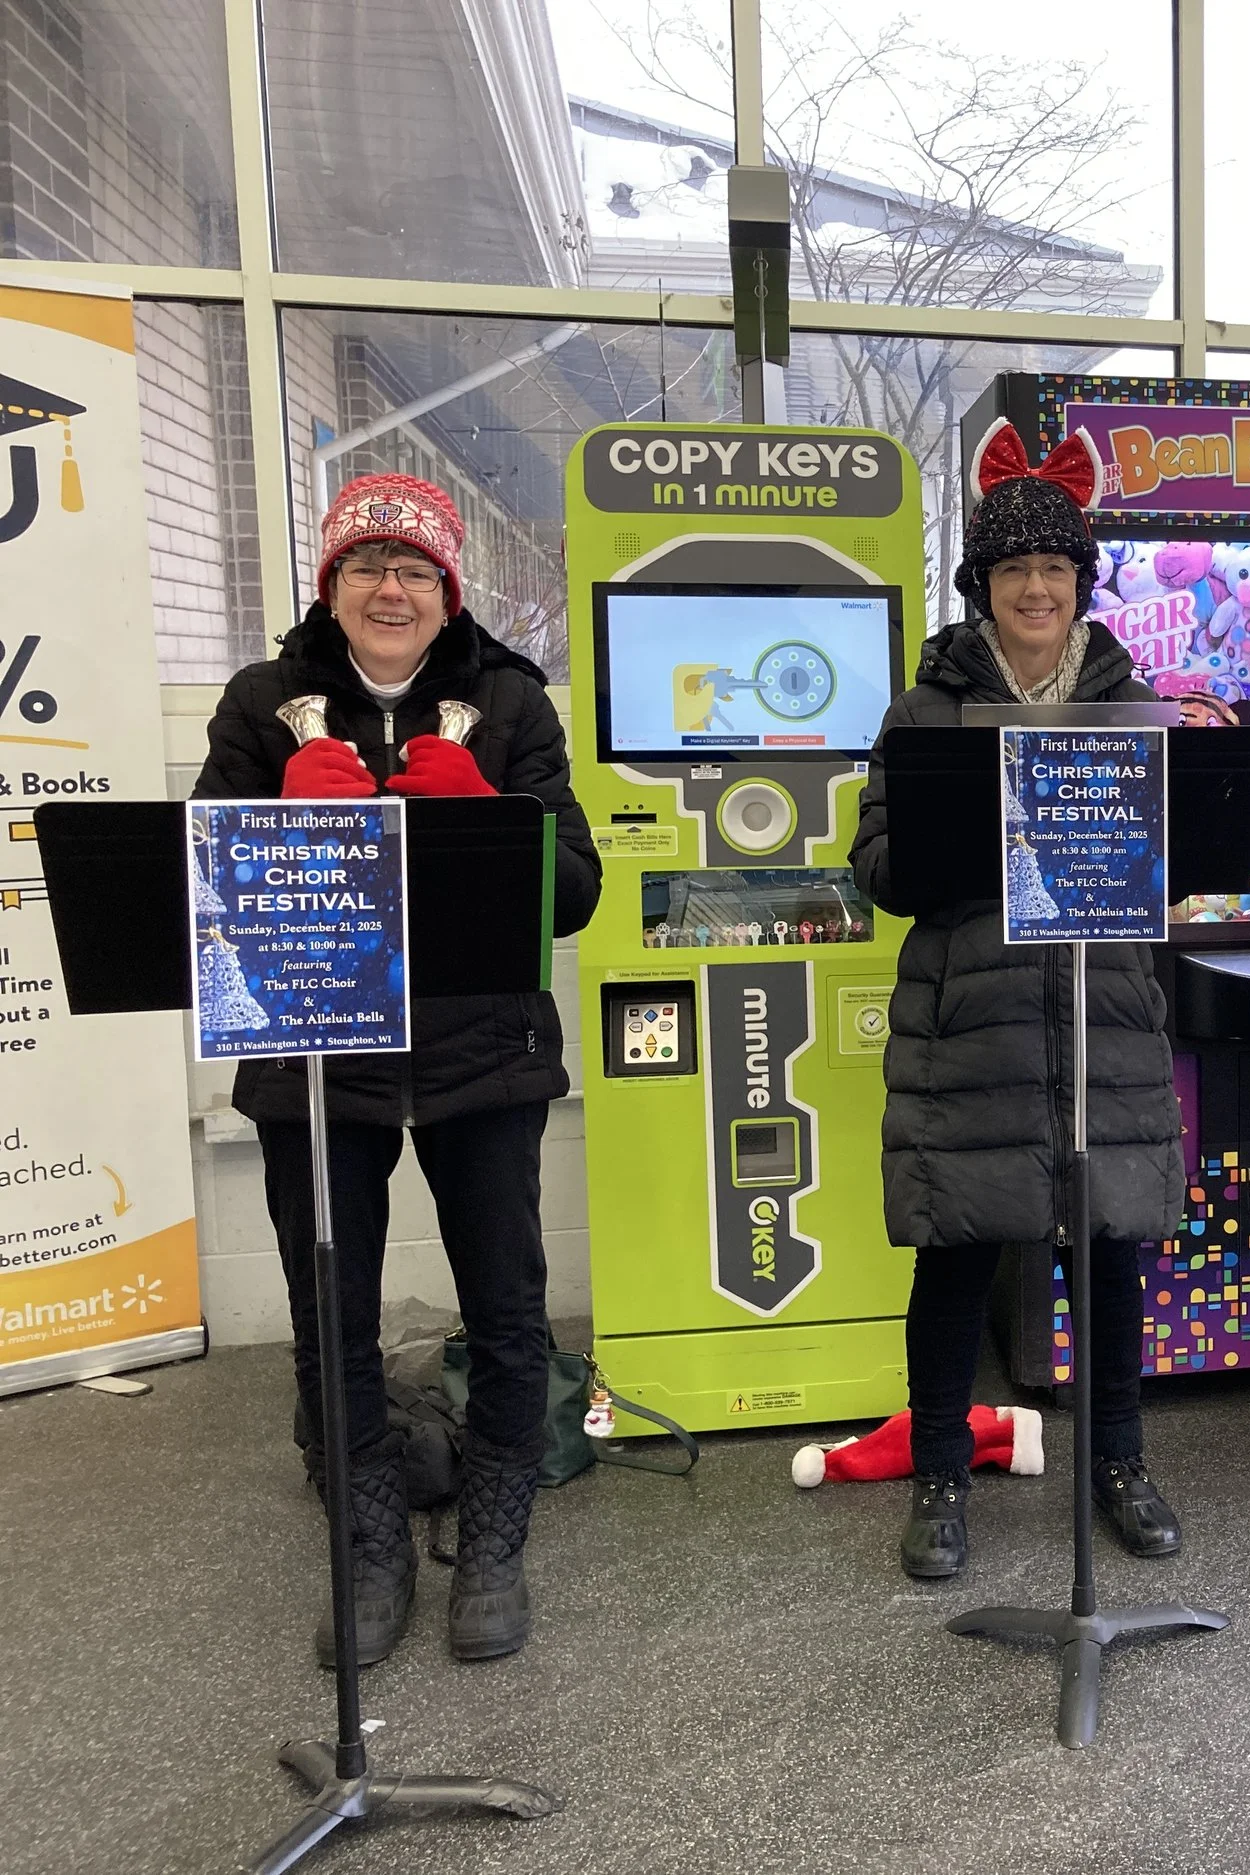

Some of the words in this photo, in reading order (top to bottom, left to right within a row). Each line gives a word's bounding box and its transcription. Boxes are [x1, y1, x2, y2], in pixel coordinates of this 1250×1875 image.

[609, 439, 742, 475] COPY
[1110, 425, 1231, 498] Bean
[693, 483, 707, 506] 1
[840, 601, 872, 610] Walmart
[1041, 738, 1068, 752] First
[1072, 738, 1137, 752] Lutheran's
[1032, 764, 1146, 779] CHRISTMAS
[22, 771, 111, 795] Books
[1057, 784, 1121, 800] CHOIR
[241, 813, 277, 828] First
[282, 812, 367, 829] Lutheran's
[1037, 806, 1143, 821] FESTIVAL
[1030, 831, 1066, 842] Sunday,
[1068, 831, 1112, 840] December
[1114, 831, 1126, 841] 21,
[1128, 831, 1148, 839] 2025
[230, 843, 379, 861] CHRISTMAS
[1052, 847, 1060, 855] at
[1061, 847, 1078, 855] 8:30
[1080, 847, 1089, 855] &
[1091, 846, 1112, 854] 10:00
[1069, 861, 1109, 873] featuring
[265, 867, 347, 885] CHOIR
[1055, 878, 1074, 887] The
[1077, 878, 1097, 887] FLC
[1099, 877, 1127, 887] Choir
[238, 892, 376, 912] FESTIVAL
[1066, 908, 1086, 917] The
[1088, 908, 1124, 917] Alleluia
[1126, 907, 1148, 917] Bells
[229, 924, 277, 937] Sunday,
[279, 921, 336, 934] December
[339, 922, 355, 934] 21,
[357, 921, 383, 932] 2025
[258, 943, 269, 952] at
[271, 942, 293, 952] 8:30
[296, 942, 306, 951] &
[309, 941, 336, 950] 10:00
[339, 942, 356, 950] am
[281, 959, 333, 973] featuring
[0, 976, 53, 994] Time
[264, 980, 289, 991] The
[292, 979, 318, 990] FLC
[321, 977, 357, 989] Choir
[303, 996, 315, 1007] &
[38, 1007, 50, 1020] a
[279, 1014, 304, 1026] The
[307, 1012, 354, 1025] Alleluia
[356, 1011, 385, 1023] Bells
[216, 1043, 232, 1053] 310
[234, 1042, 241, 1051] E
[243, 1039, 298, 1052] Washington
[300, 1038, 310, 1048] St
[327, 1035, 377, 1047] Stoughton,
[378, 1035, 392, 1044] WI
[32, 1221, 80, 1240] more
[85, 1213, 104, 1228] at
[0, 1233, 117, 1268] betteru.com
[52, 1326, 75, 1337] Live
[77, 1318, 116, 1332] better.
